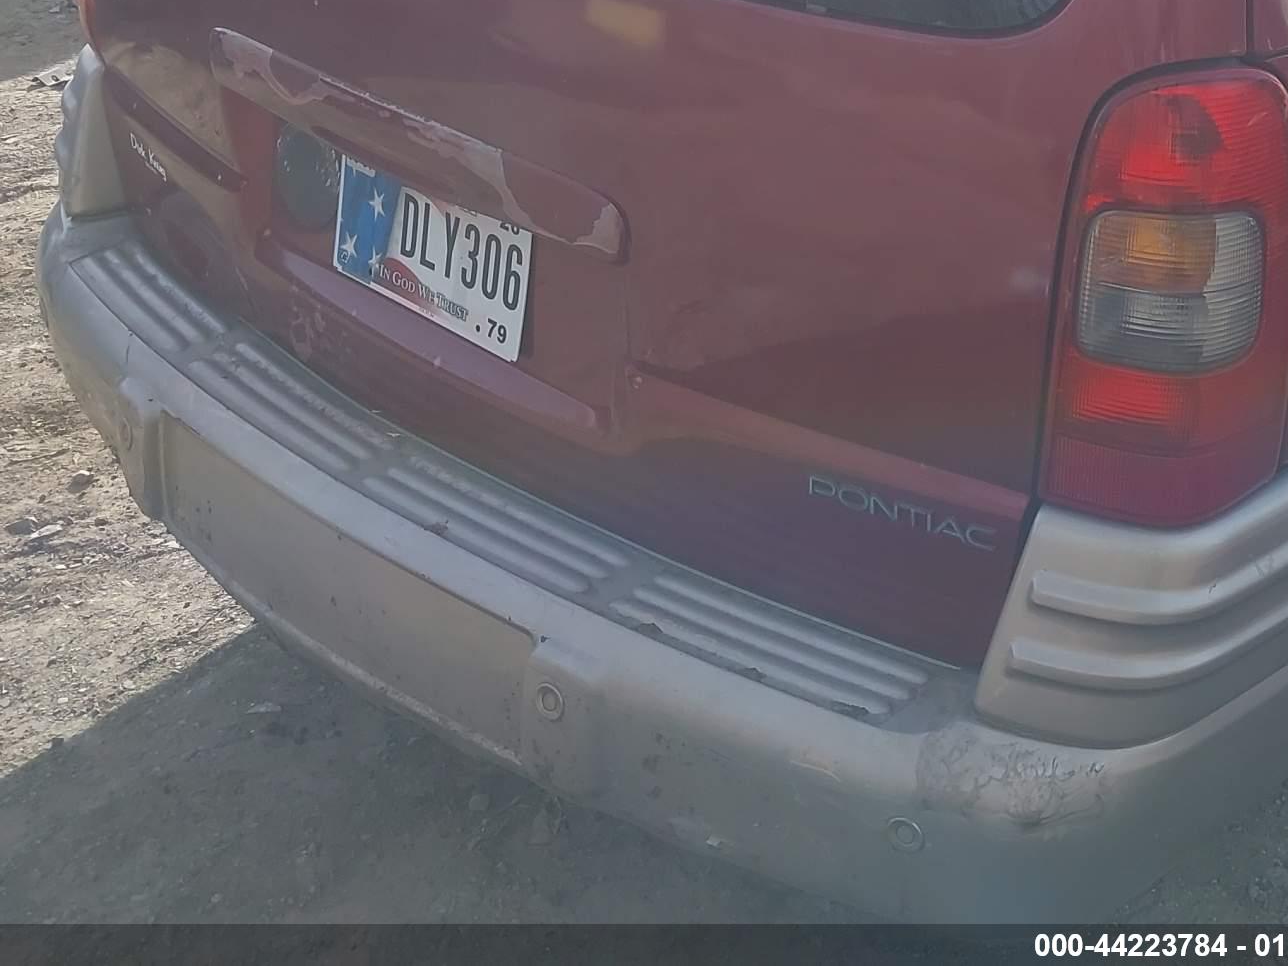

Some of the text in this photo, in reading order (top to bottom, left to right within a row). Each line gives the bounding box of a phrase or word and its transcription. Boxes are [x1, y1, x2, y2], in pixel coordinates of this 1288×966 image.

[400, 192, 523, 312] DLY306
[379, 264, 393, 281] IN
[392, 270, 416, 293] GOD
[417, 284, 436, 305] WE
[436, 292, 469, 322] TRUST
[487, 319, 508, 344] 79
[808, 473, 998, 552] PONTIAC
